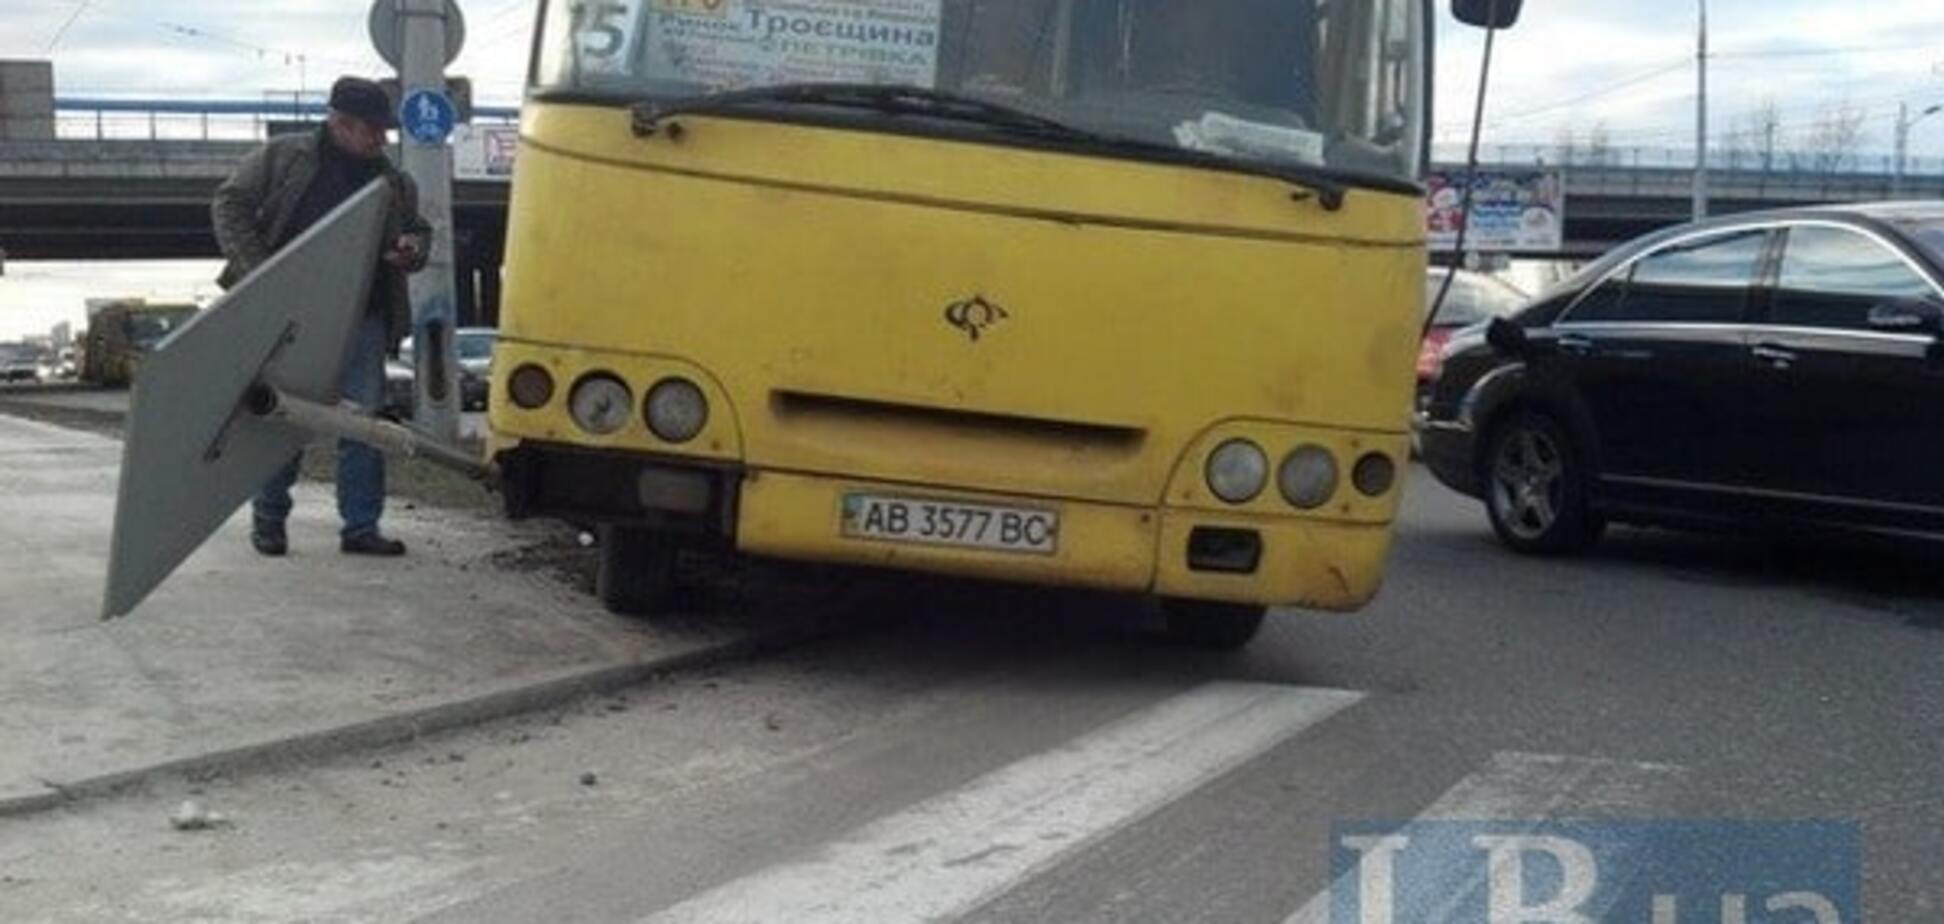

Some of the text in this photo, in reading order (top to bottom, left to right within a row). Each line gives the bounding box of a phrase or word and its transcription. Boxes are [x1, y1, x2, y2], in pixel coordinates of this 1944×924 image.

[865, 502, 1047, 546] AB 3577 BC
